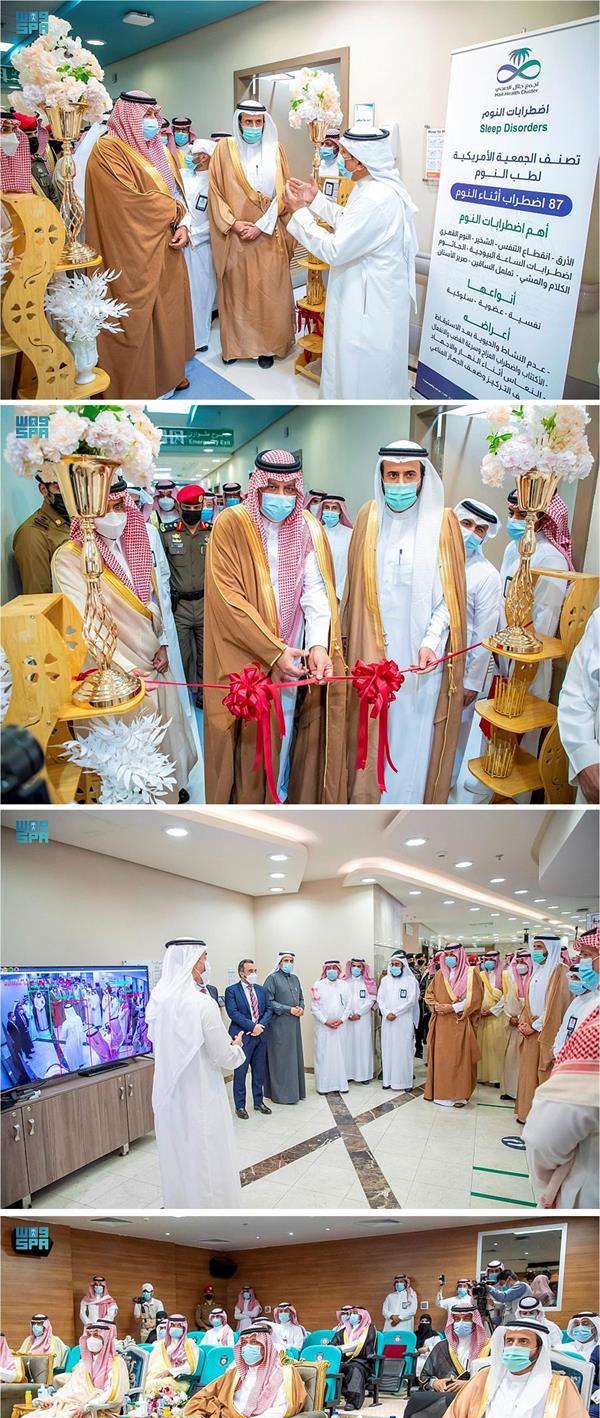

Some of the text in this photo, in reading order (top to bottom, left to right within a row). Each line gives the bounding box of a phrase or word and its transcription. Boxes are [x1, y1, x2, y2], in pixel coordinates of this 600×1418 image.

[482, 104, 549, 119] اضطرابات النوم
[480, 123, 548, 134] Sleep Disorders
[453, 150, 495, 163] الأمريكية
[496, 152, 537, 165] الجمعية
[475, 169, 541, 182] لطب النوم
[456, 189, 563, 210] 87 اضطراب أثناء النوم
[459, 214, 549, 239] أهم اضطرابات النوم
[459, 233, 471, 241] النوم
[474, 237, 494, 246] الشخير
[498, 244, 522, 253] التنفس
[522, 248, 550, 260] انقطاع
[471, 260, 495, 272] الساقين
[496, 253, 526, 267] الساعة
[556, 256, 574, 266] الأرق
[526, 263, 572, 280] اضطرابات
[520, 275, 548, 289] والمشي
[548, 283, 570, 294] الكلام
[467, 278, 516, 305] أنواعها
[447, 287, 541, 330] نفسية عضوية سلوكية
[461, 328, 472, 337] بعد
[463, 314, 511, 341] أعراضه
[473, 333, 500, 352] والحيوية
[447, 353, 463, 367] الجهاز
[458, 348, 481, 365] النهار
[501, 346, 526, 363] النشاط
[464, 364, 485, 381] وضعف
[526, 361, 546, 374] عدم
[486, 376, 511, 395] التركيز
[503, 376, 542, 399] النعاس
